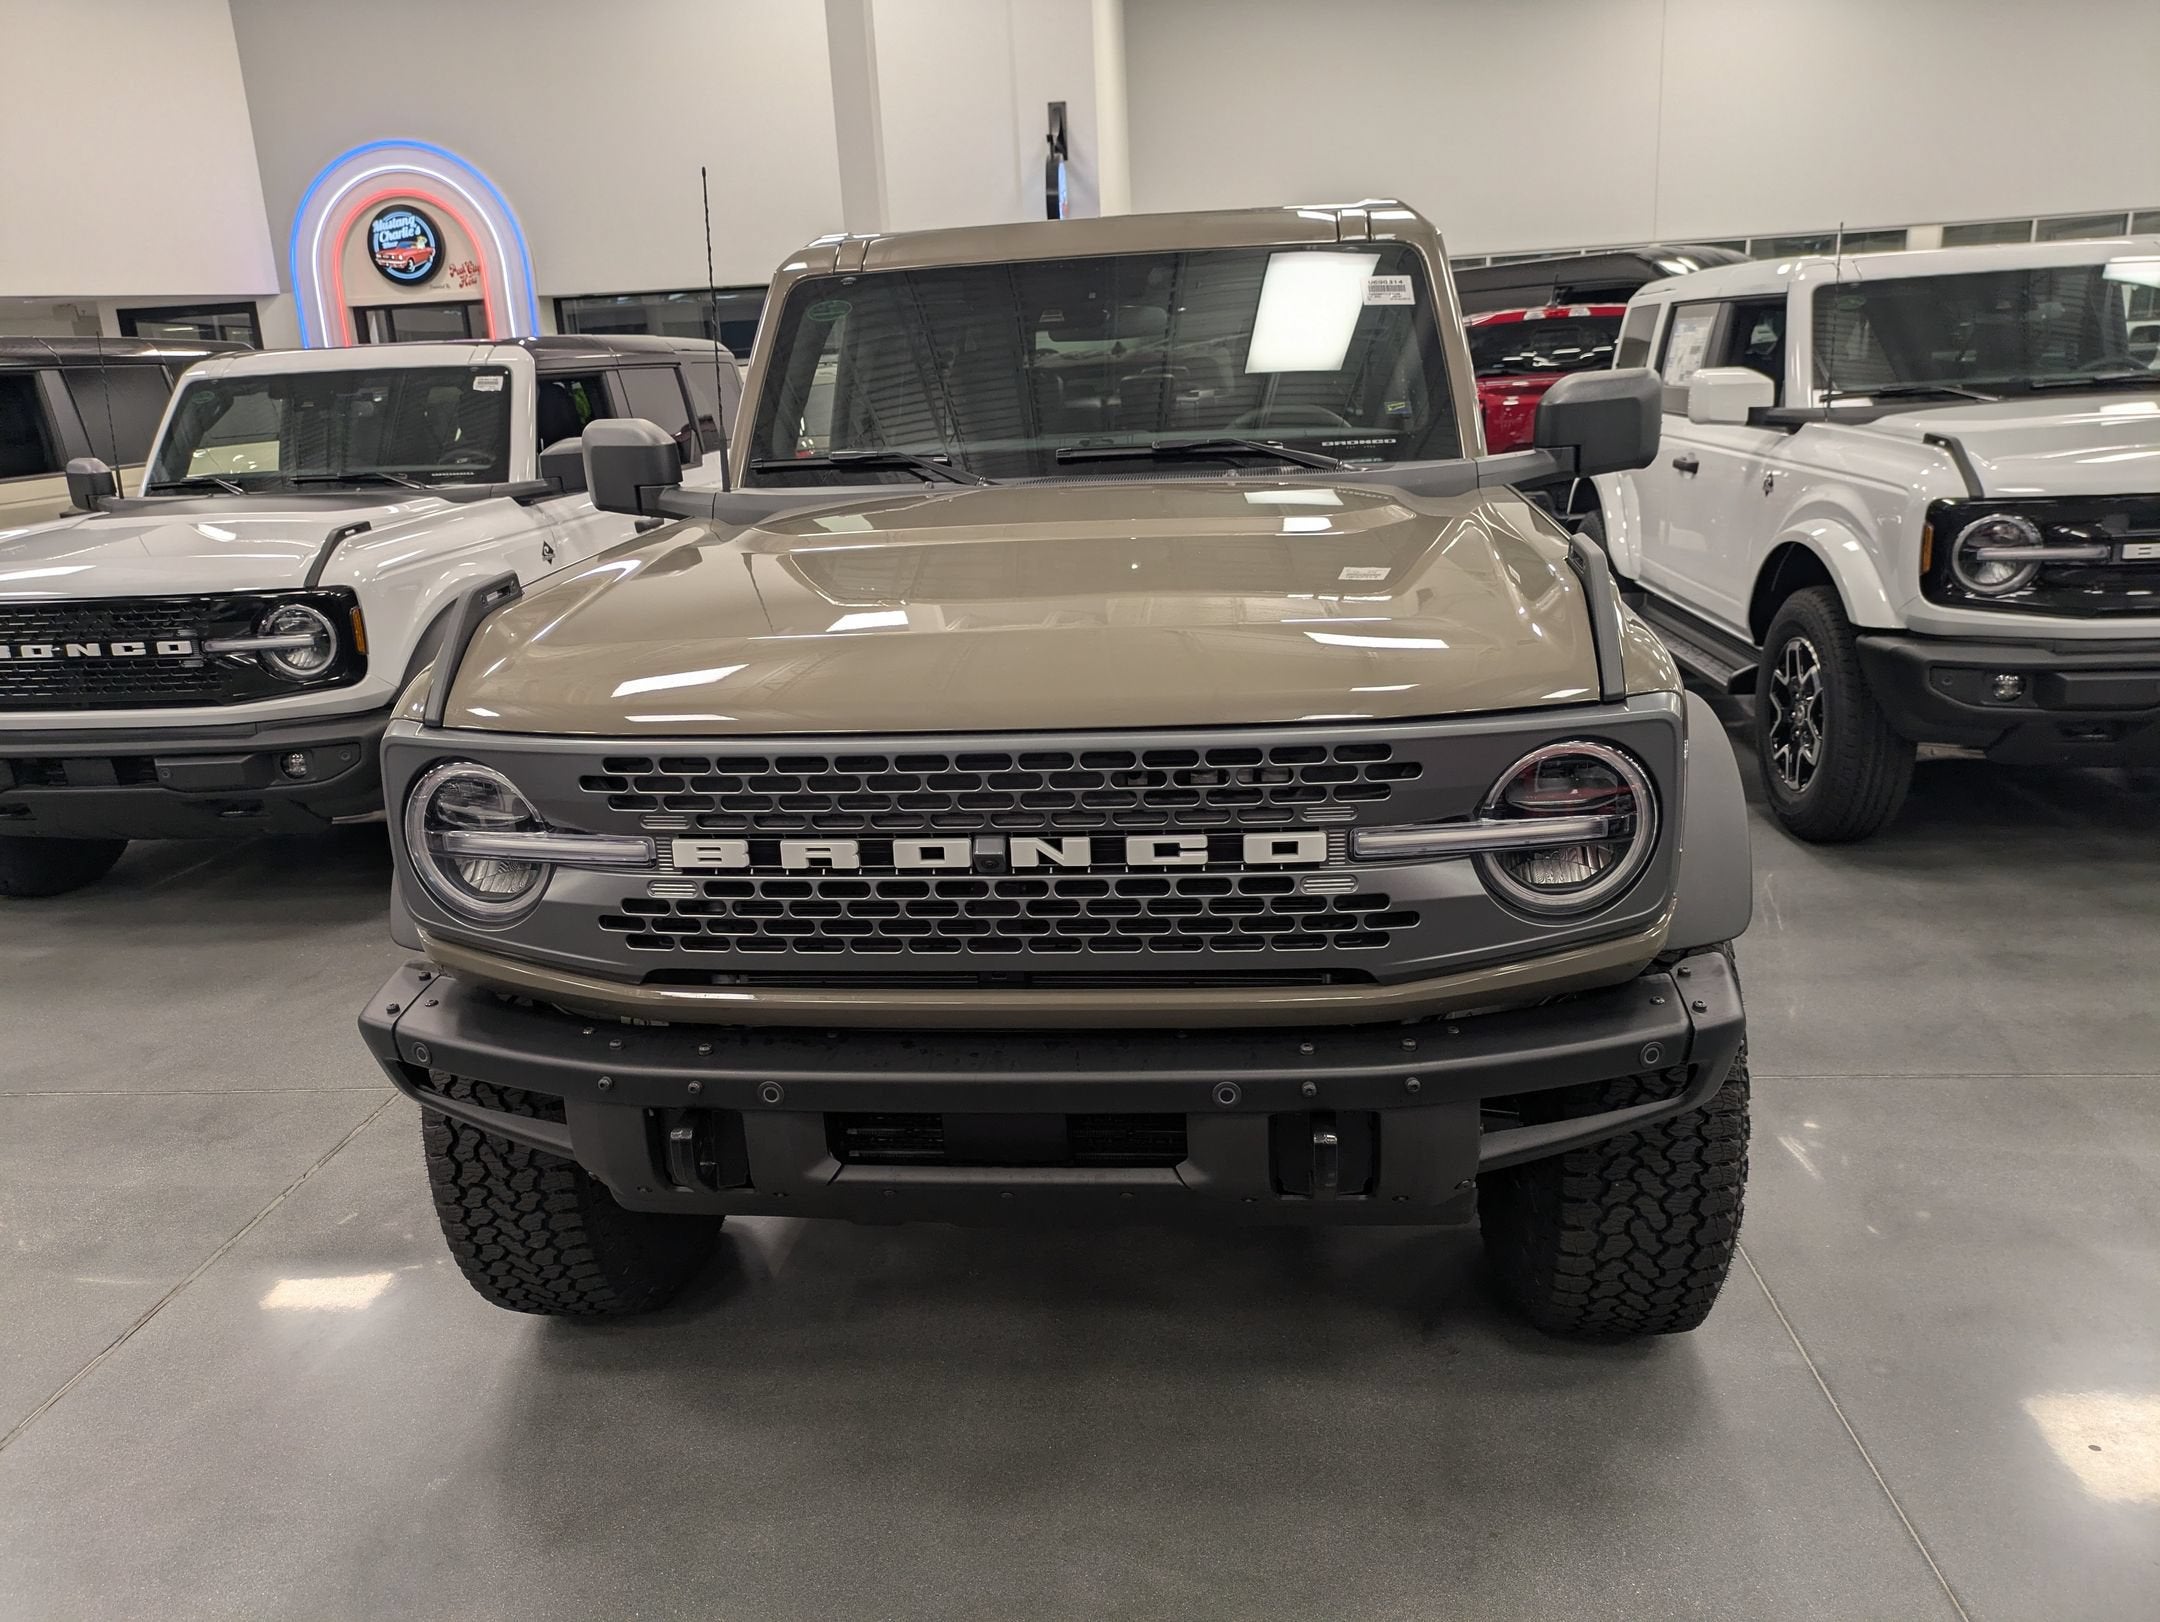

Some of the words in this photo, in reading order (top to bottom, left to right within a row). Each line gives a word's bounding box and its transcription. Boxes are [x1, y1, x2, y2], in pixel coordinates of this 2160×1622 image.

[372, 215, 417, 233] Mustang
[379, 225, 421, 243] Charlie's
[1321, 438, 1396, 447] BRONCO
[671, 831, 1327, 869] BRONCO
